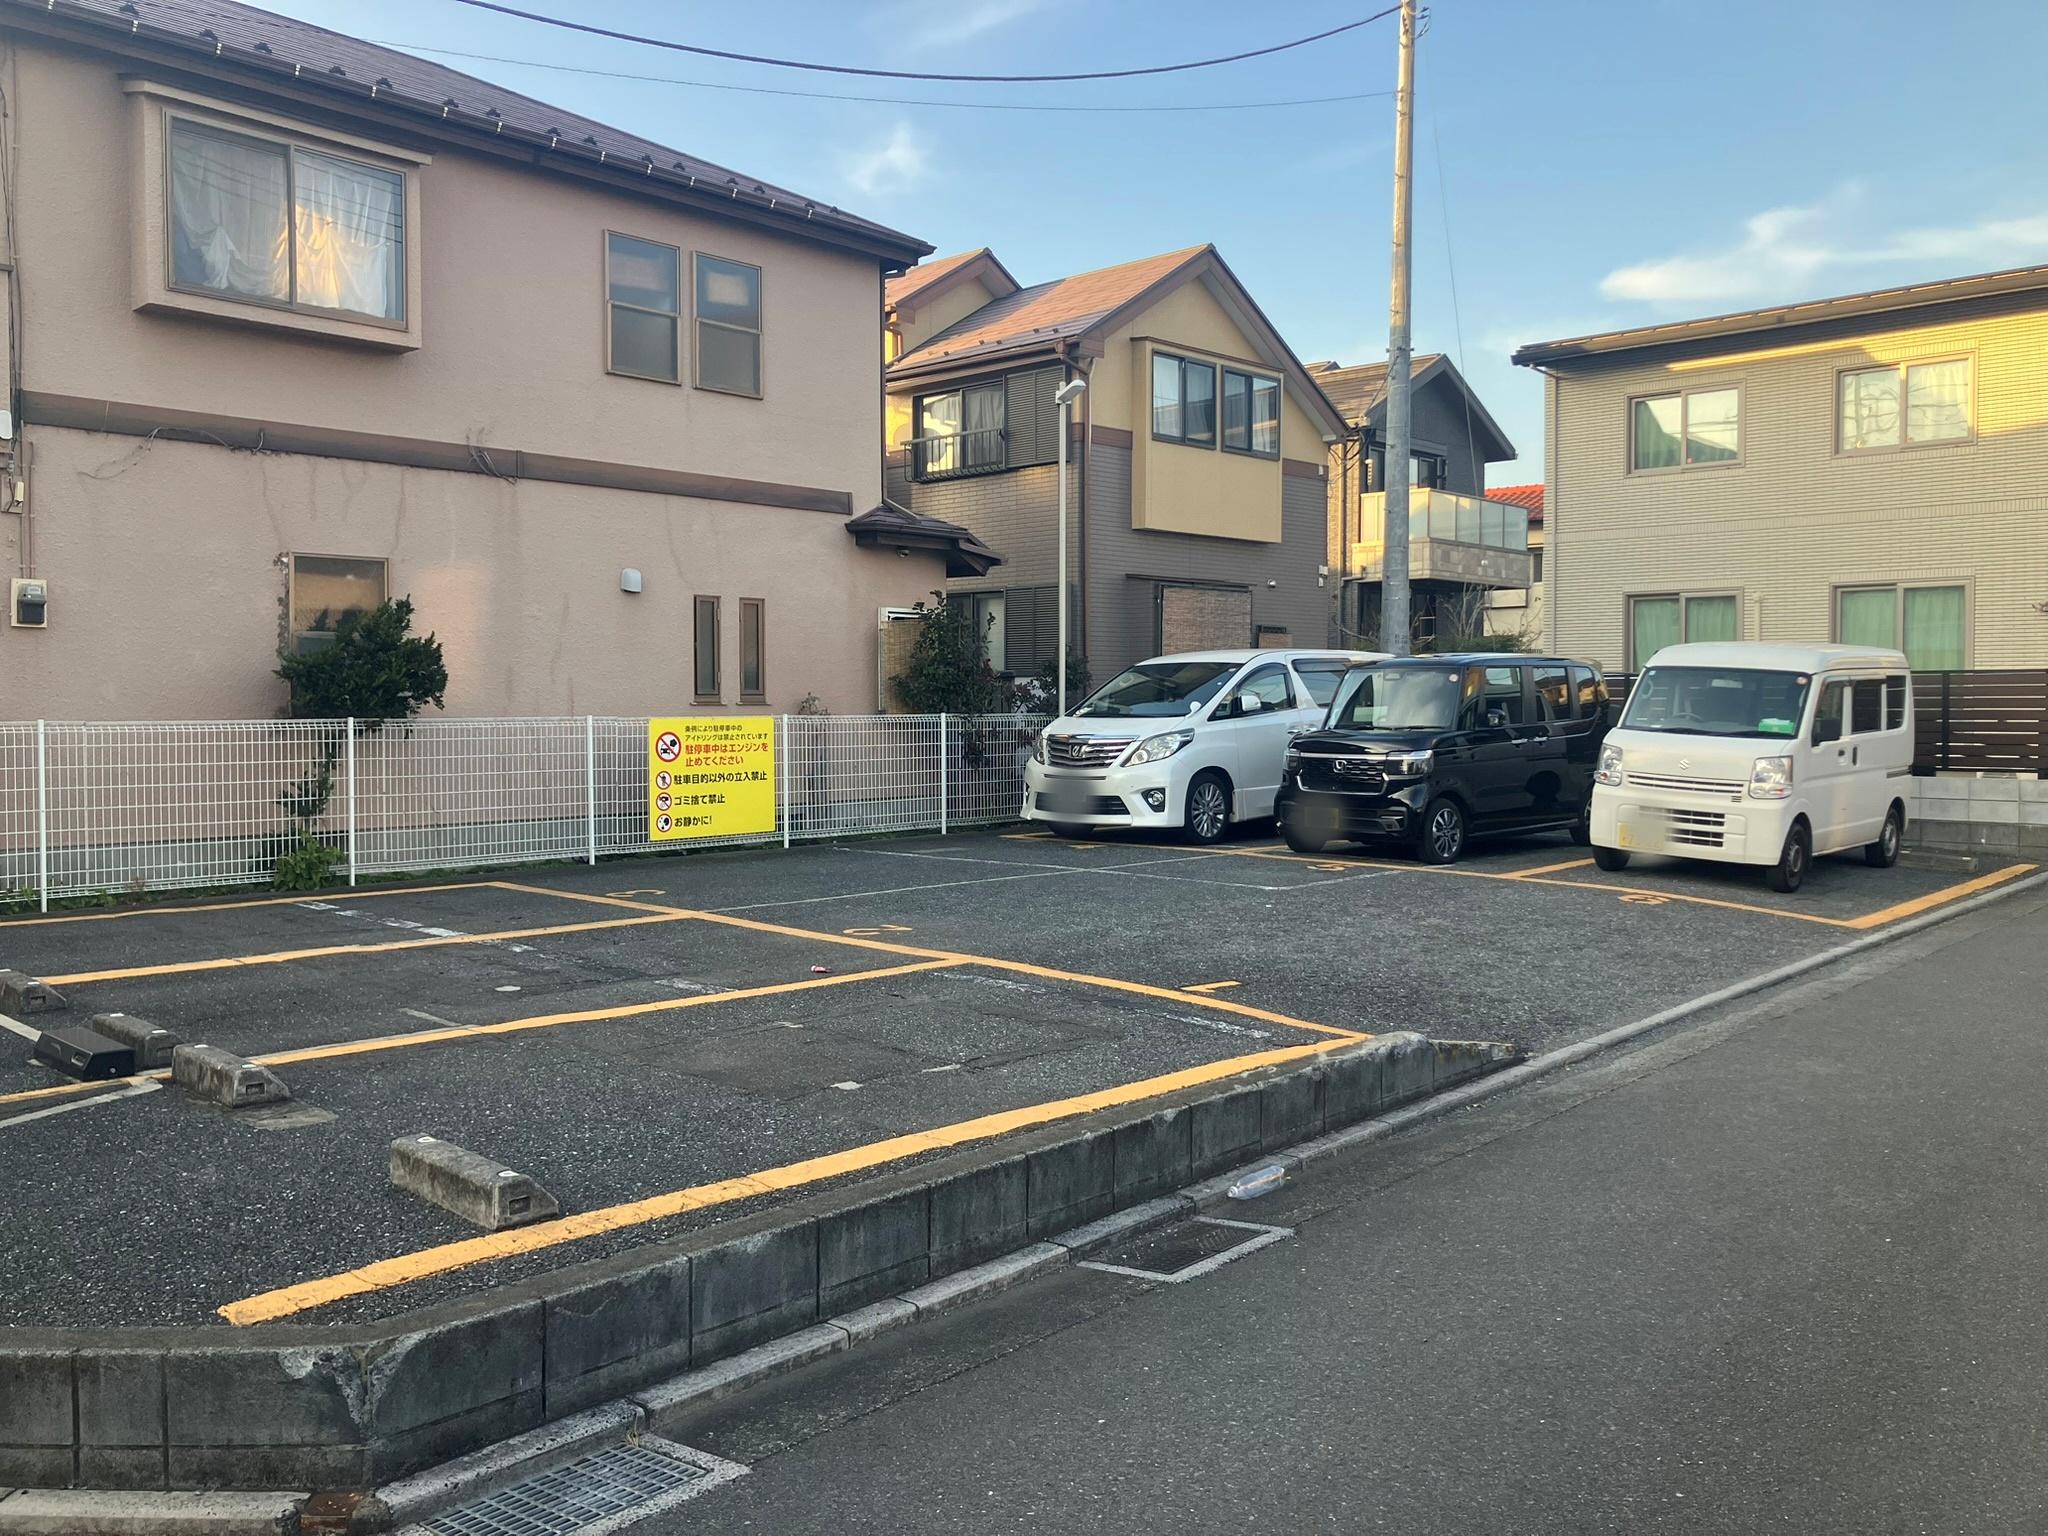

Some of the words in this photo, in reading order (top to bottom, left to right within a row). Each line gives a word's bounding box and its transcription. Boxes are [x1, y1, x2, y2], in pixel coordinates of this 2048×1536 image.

[685, 733, 768, 742] アイドリングは禁止されています
[685, 742, 769, 755] 駐停車中はエンジンを
[685, 756, 744, 767] 止めてください
[673, 771, 768, 785] 駐車目的以外の立入禁止
[674, 794, 725, 806] ゴミ捨て禁止
